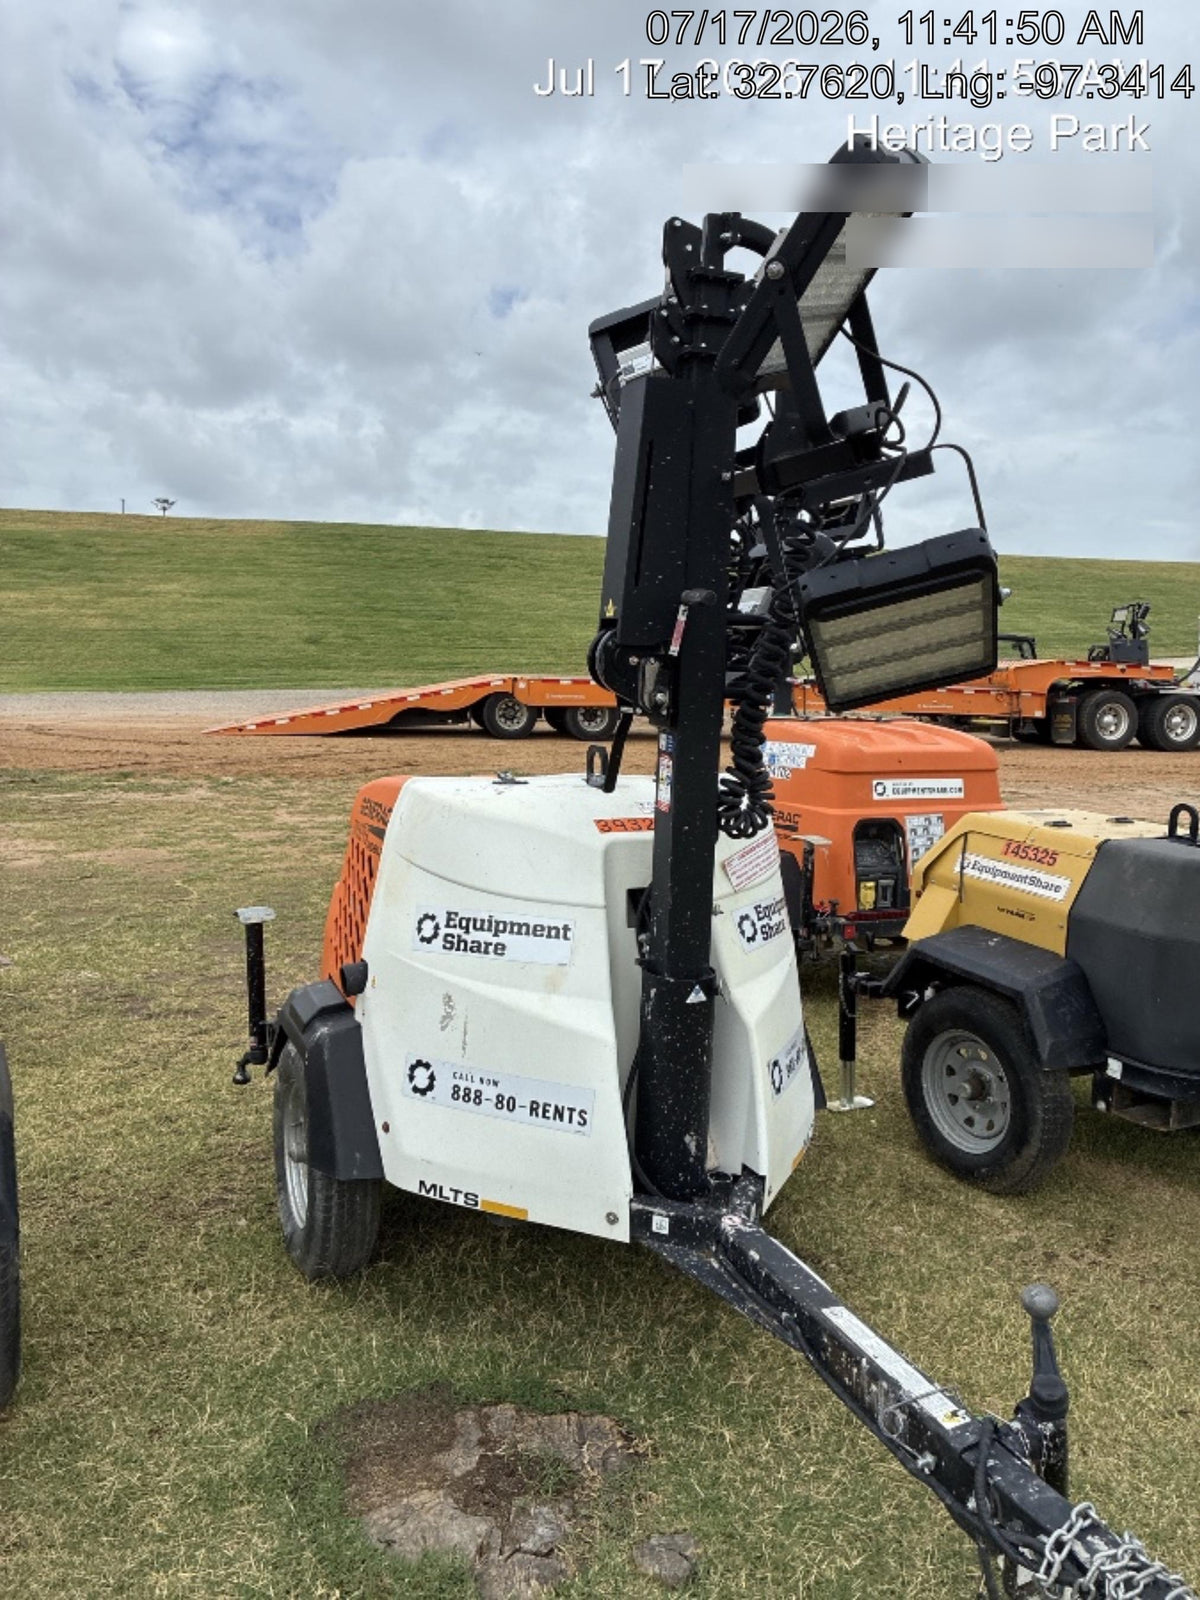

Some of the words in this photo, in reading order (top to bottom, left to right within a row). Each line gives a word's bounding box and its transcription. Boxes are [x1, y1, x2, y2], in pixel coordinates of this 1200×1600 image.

[1003, 842, 1059, 867] 145325
[970, 860, 1062, 894] EquipmentShare
[444, 910, 572, 941] Equipment
[442, 932, 507, 957] Share
[452, 1071, 476, 1084] CALL
[479, 1076, 500, 1088] NOW
[451, 1084, 588, 1128] 888-80-RENTS
[418, 1179, 479, 1208] MLTS
